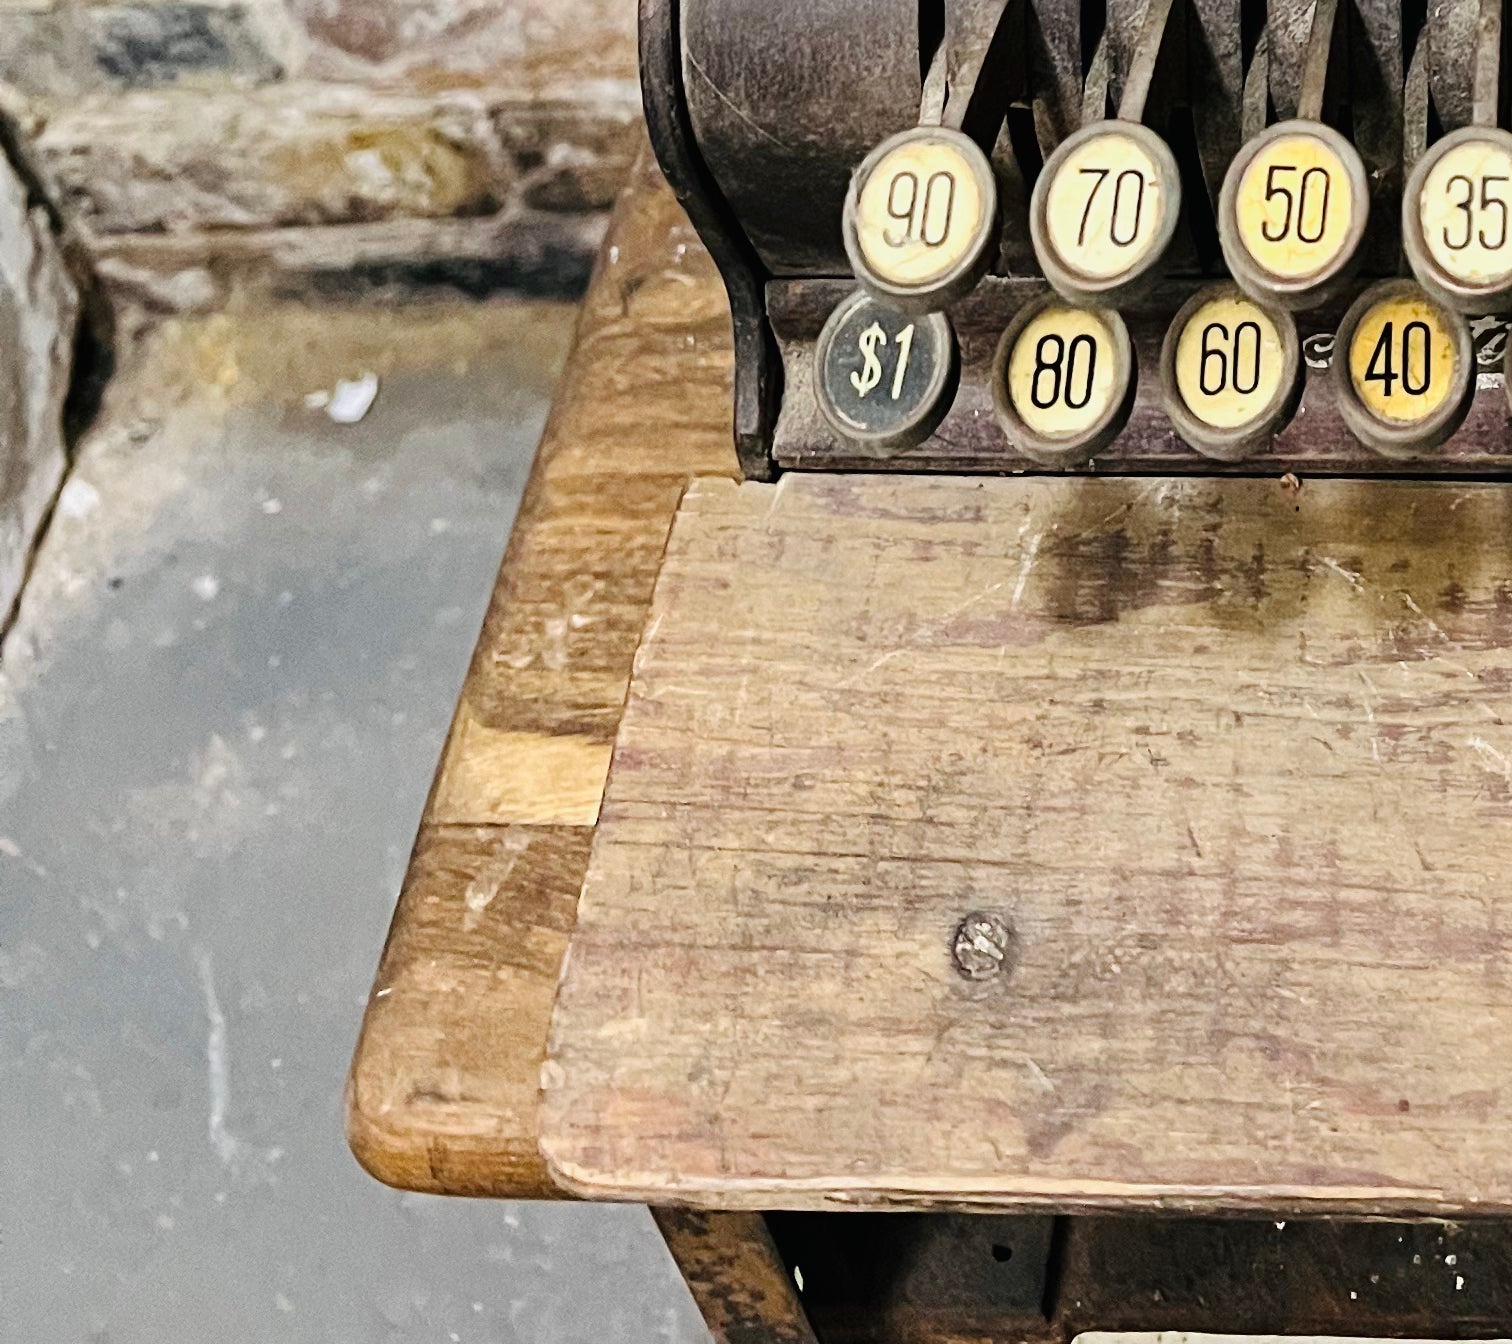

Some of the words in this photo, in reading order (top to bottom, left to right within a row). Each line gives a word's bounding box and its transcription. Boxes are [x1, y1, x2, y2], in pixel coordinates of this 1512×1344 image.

[885, 170, 956, 248] 90
[1078, 167, 1143, 247] 70
[1262, 165, 1329, 243] 50
[1444, 174, 1508, 251] 35
[849, 320, 915, 401] $1
[1030, 333, 1097, 410] 80
[1199, 321, 1261, 396] 60
[1364, 321, 1432, 397] 40
